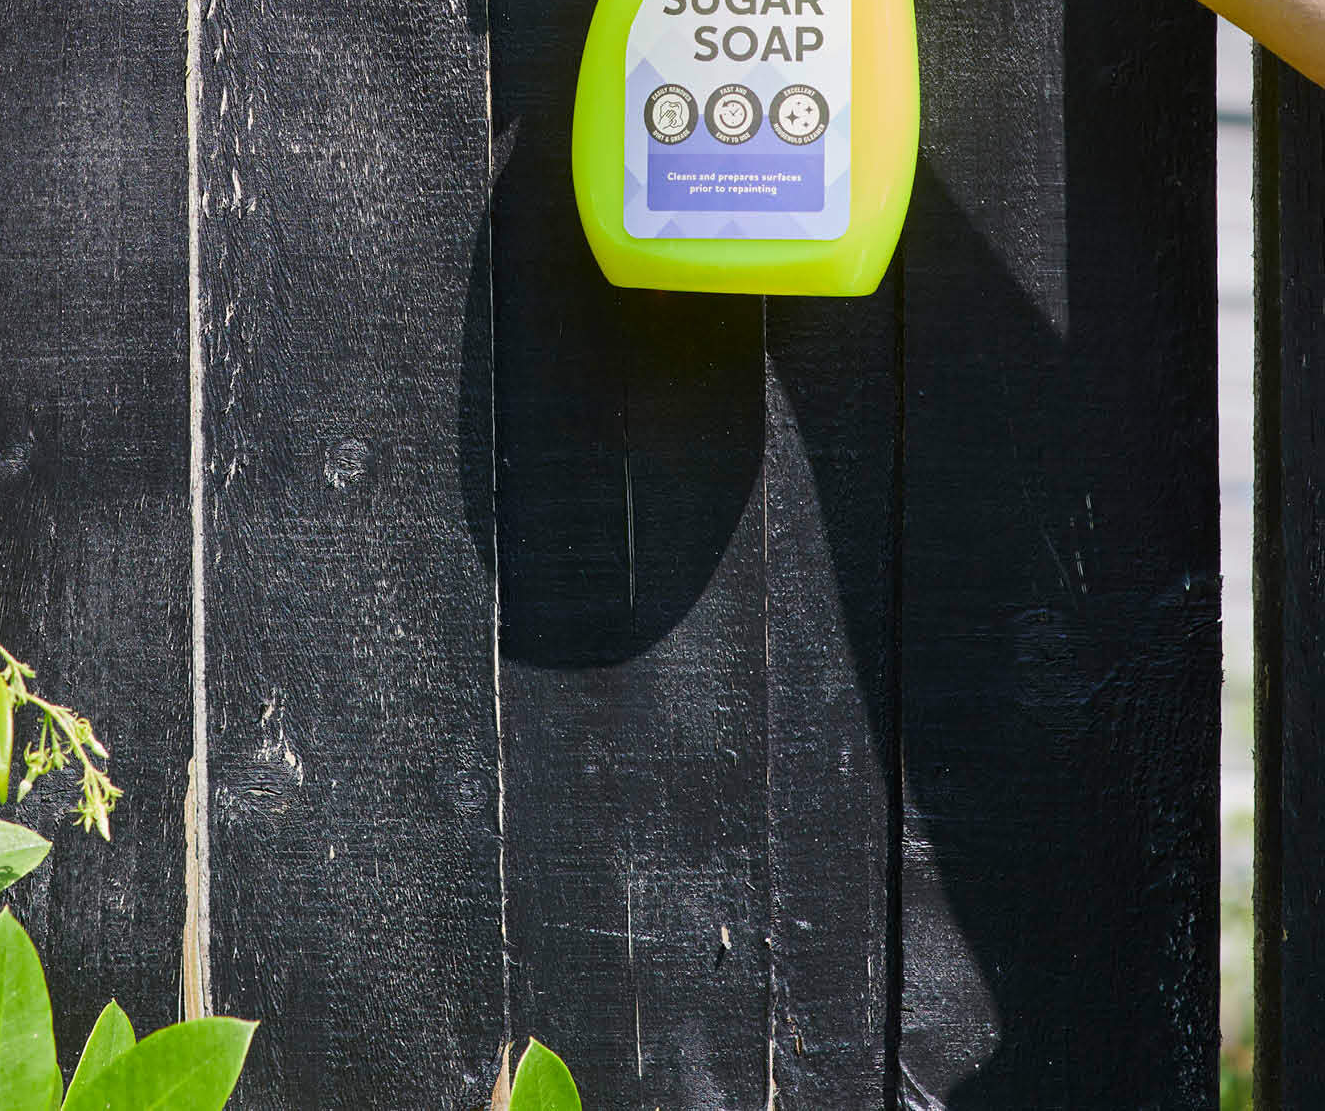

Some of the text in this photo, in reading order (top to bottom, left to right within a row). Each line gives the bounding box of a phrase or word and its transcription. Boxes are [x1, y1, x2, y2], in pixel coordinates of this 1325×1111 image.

[693, 25, 824, 62] SOAP
[667, 172, 802, 183] Cleans and prepares surfaces
[689, 184, 777, 195] prior to repainting
